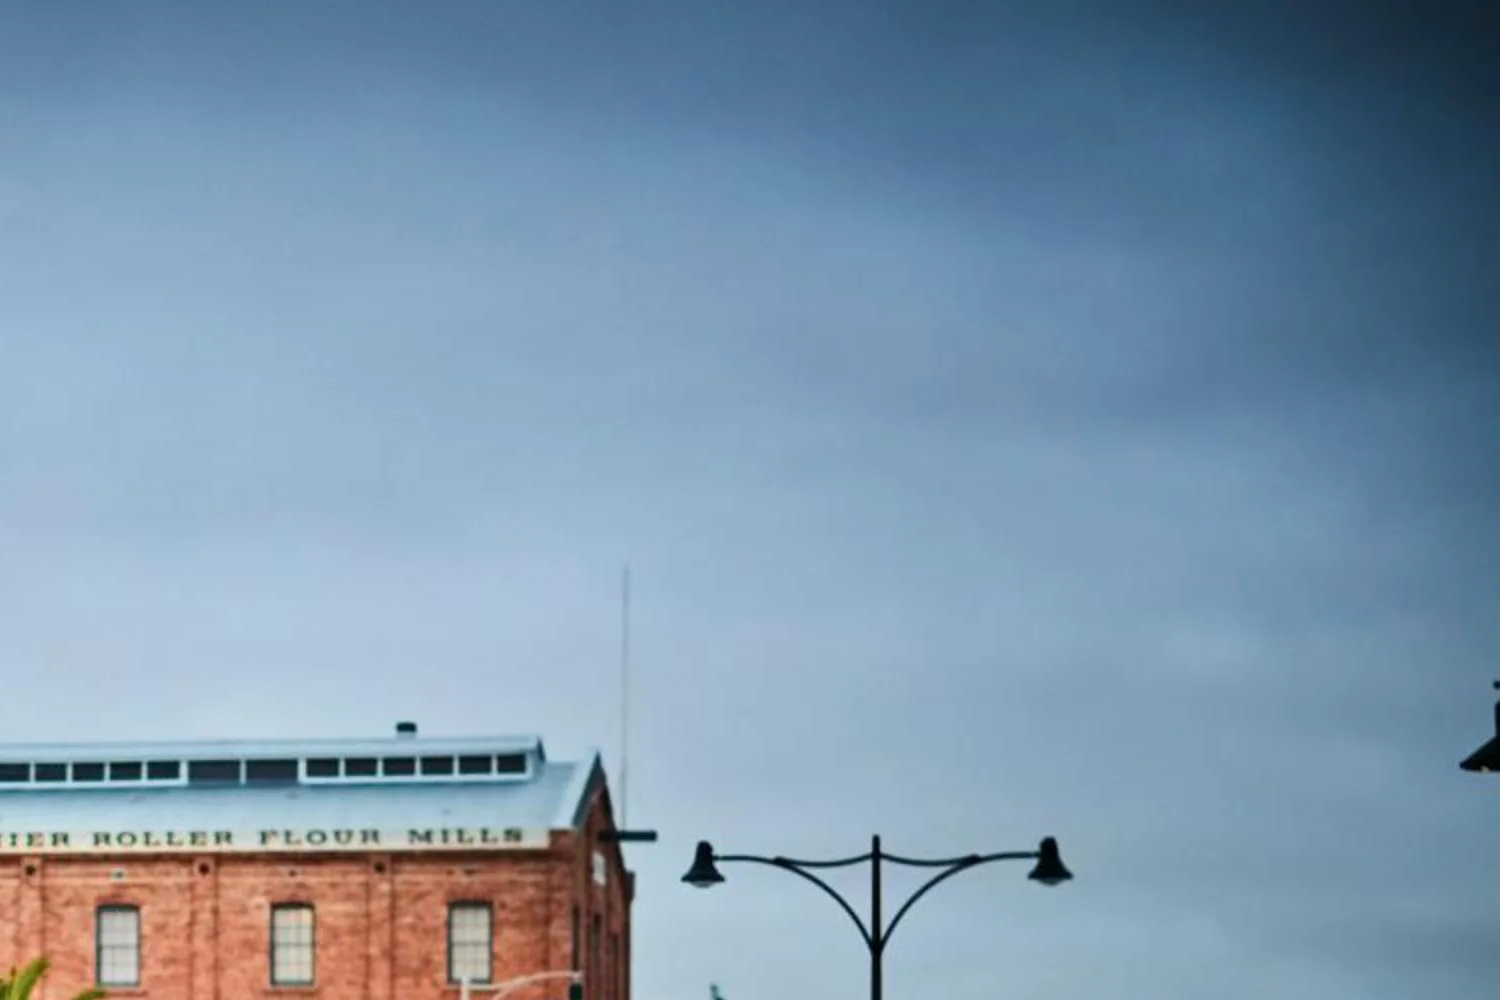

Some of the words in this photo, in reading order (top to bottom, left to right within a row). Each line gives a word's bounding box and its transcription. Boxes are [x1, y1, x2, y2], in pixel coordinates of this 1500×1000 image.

[92, 830, 234, 847] ROLLER
[260, 828, 381, 846] FLOUR
[407, 827, 524, 845] MILLS
